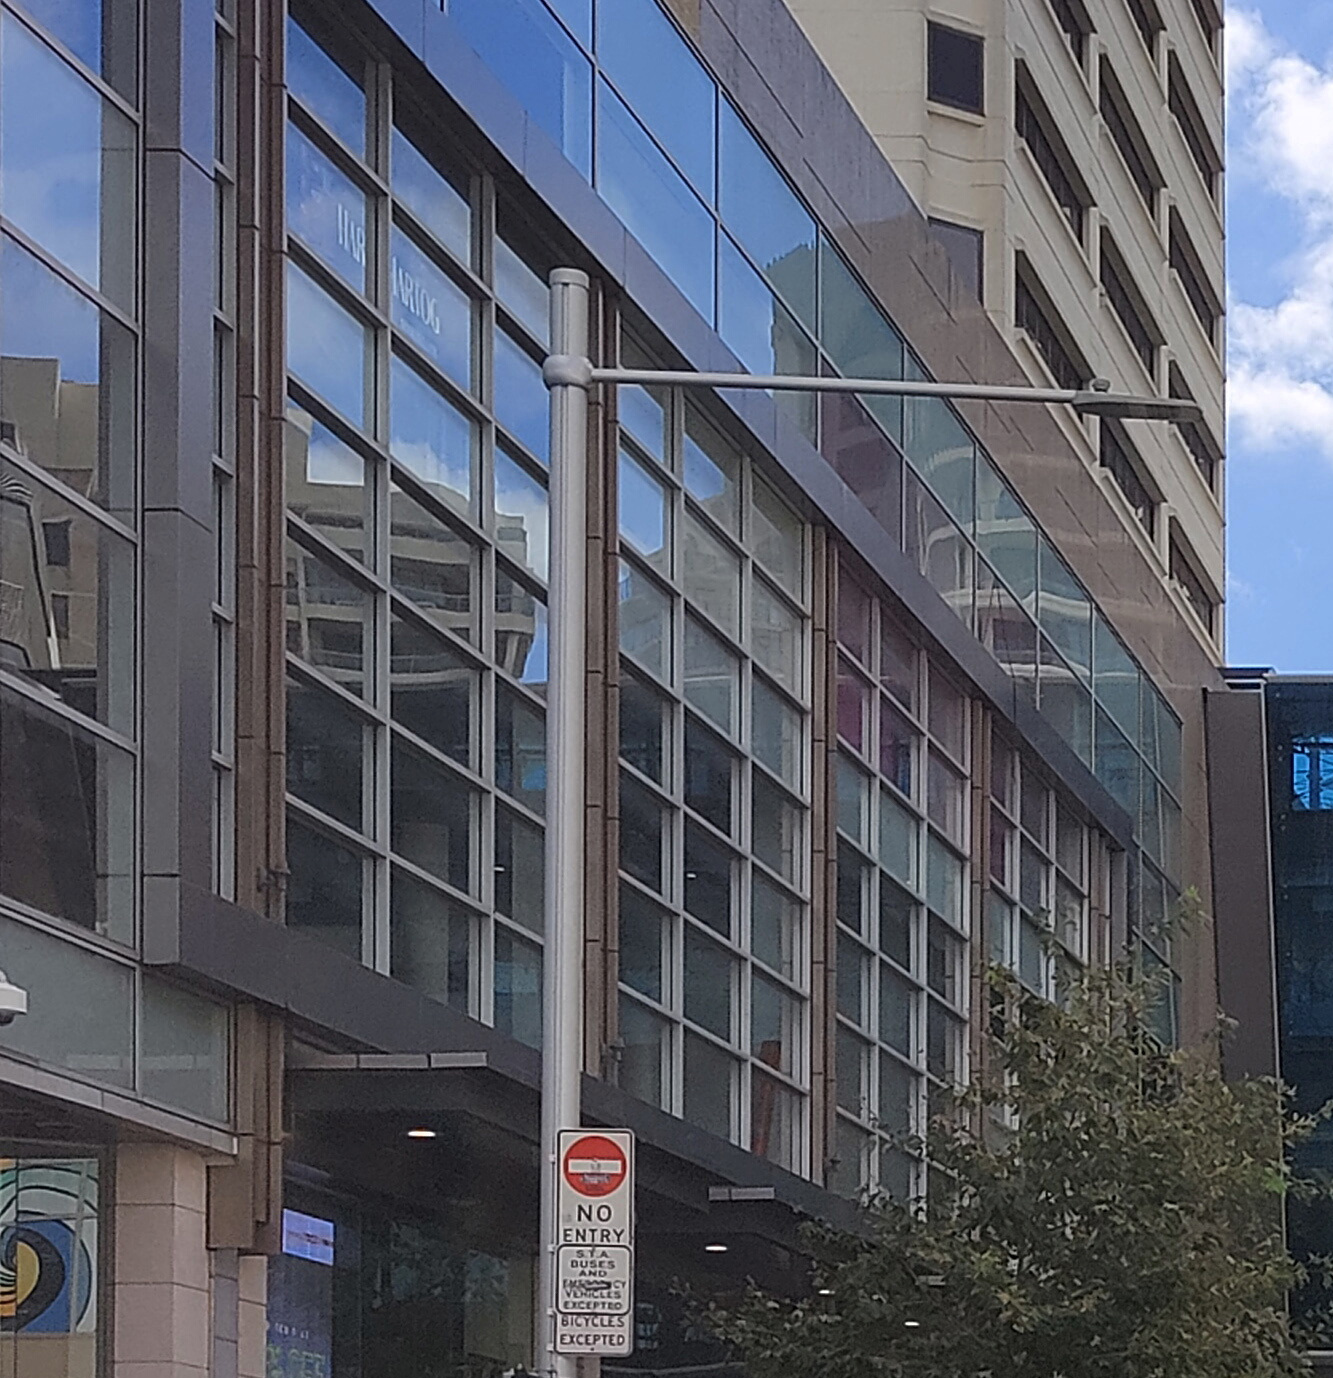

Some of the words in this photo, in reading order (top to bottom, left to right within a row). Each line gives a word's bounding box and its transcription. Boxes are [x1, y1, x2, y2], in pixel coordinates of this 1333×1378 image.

[577, 1204, 613, 1222] NO
[562, 1228, 626, 1243] ENTRY
[570, 1260, 616, 1269] BUSES
[578, 1270, 608, 1278] AND
[563, 1301, 623, 1310] EXCEPTED
[561, 1316, 625, 1328] BICYCLES
[559, 1333, 626, 1346] EXCEPTED
